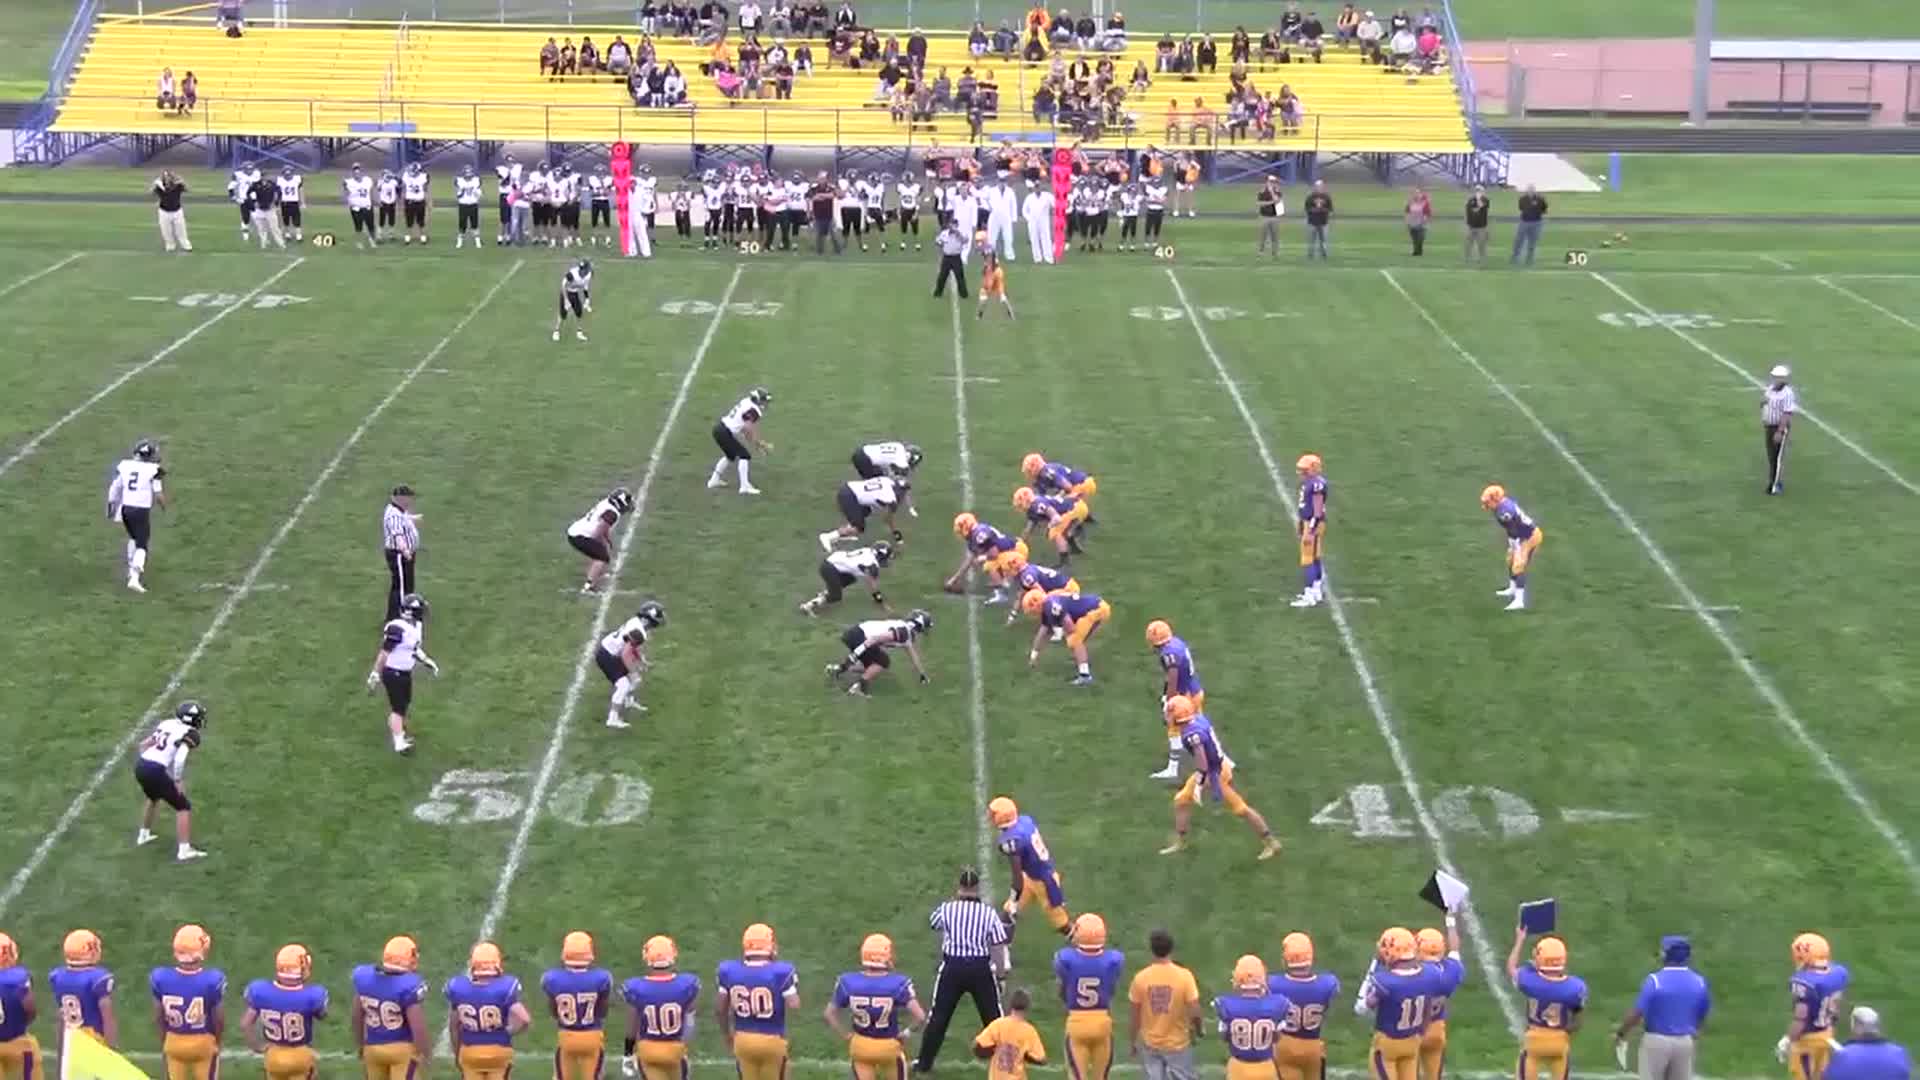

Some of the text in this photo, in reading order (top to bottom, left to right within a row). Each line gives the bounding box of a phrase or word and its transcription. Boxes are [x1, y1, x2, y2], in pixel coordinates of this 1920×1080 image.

[313, 235, 333, 247] 40
[740, 241, 760, 254] 50
[1155, 246, 1174, 258] 40
[127, 471, 140, 491] 2
[413, 769, 653, 827] 50
[1308, 784, 1541, 838] 40
[730, 984, 774, 1019] 60
[1076, 977, 1101, 1008] 5
[61, 994, 84, 1027] 8
[161, 995, 207, 1029] 54
[260, 1009, 305, 1042] 58
[555, 993, 599, 1026] 87
[643, 1003, 682, 1035] 10
[849, 996, 894, 1028] 57
[1397, 995, 1425, 1030] 11
[1230, 1018, 1275, 1050] 80
